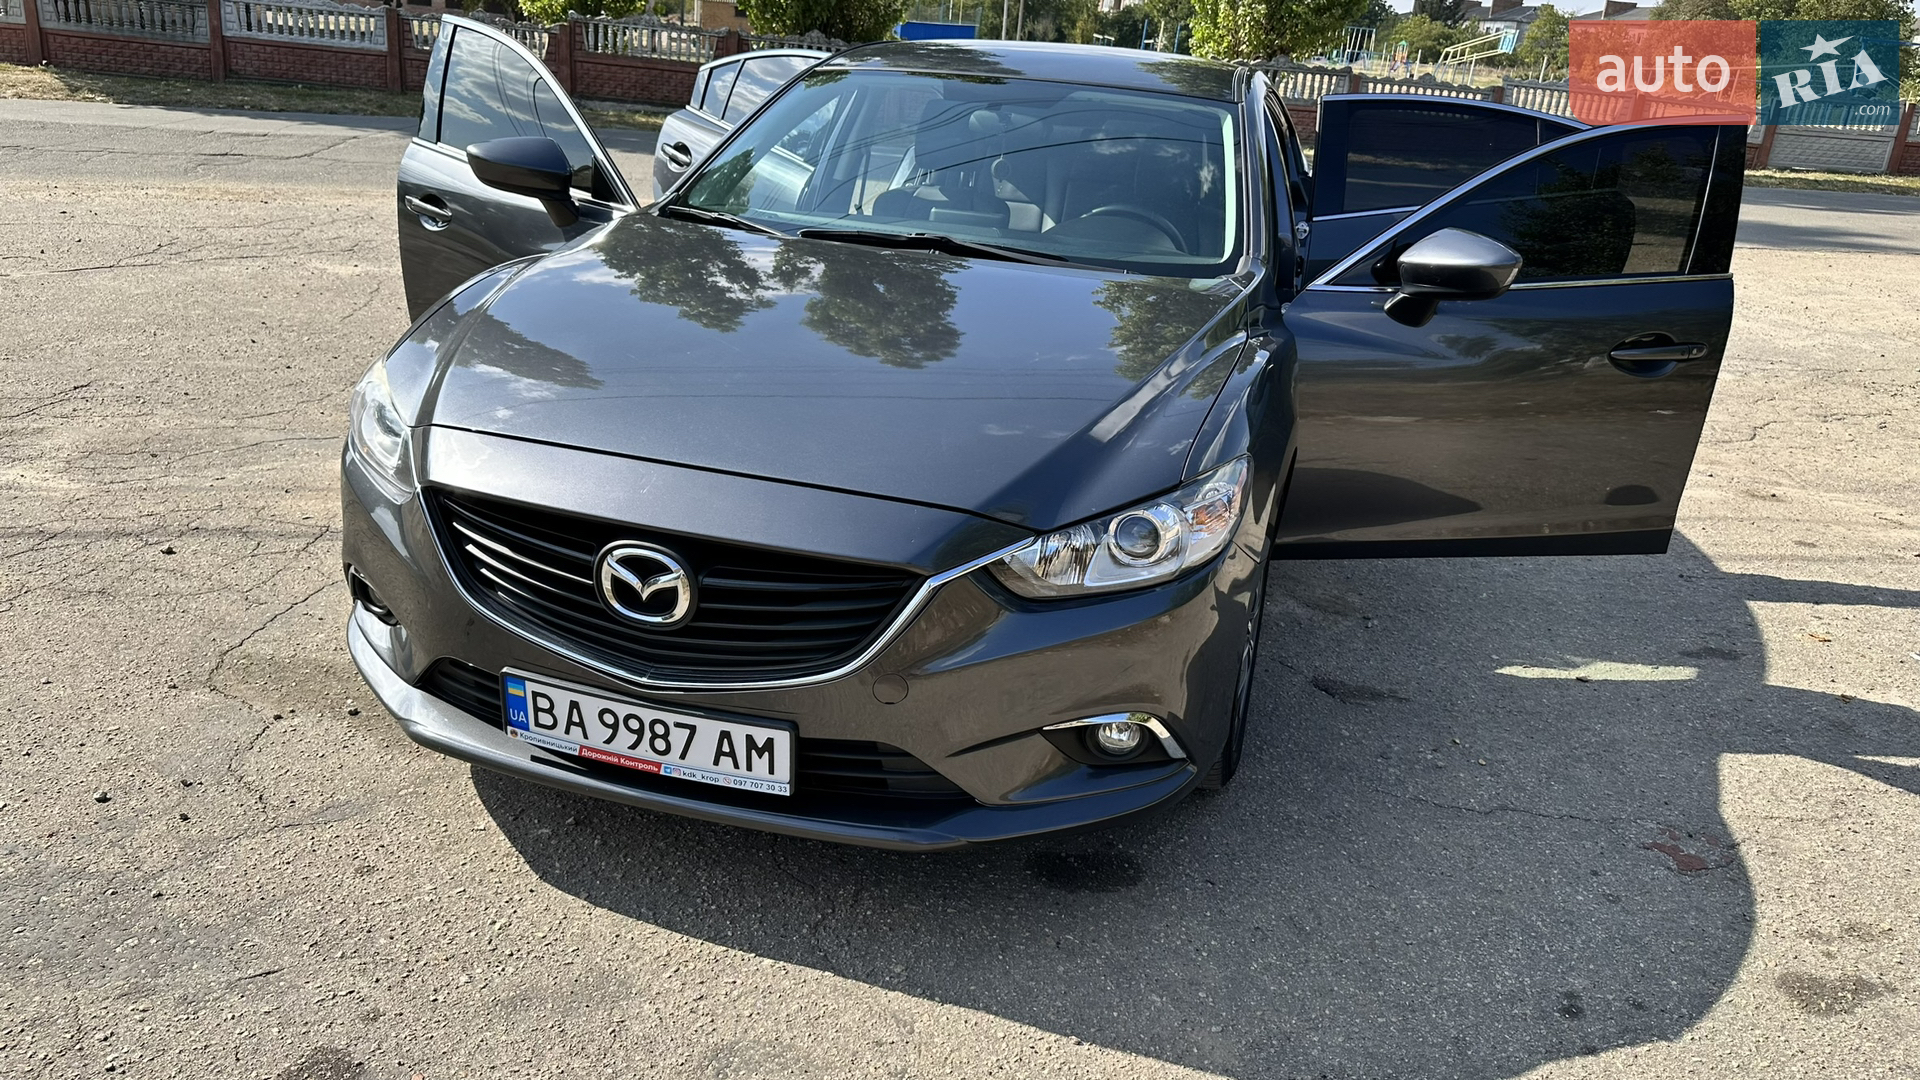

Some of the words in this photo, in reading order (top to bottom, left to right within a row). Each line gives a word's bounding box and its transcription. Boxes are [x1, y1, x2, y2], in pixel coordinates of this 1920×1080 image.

[509, 708, 527, 724] UA
[519, 732, 578, 753] Кропивницький
[531, 690, 589, 740] BA
[597, 707, 697, 760] 9987
[712, 730, 775, 775] AM
[581, 748, 619, 763] Дорожній
[620, 757, 659, 772] Контроль
[733, 778, 747, 788] 097
[749, 781, 764, 790] 707
[766, 783, 776, 792] 30
[777, 785, 788, 793] 33
